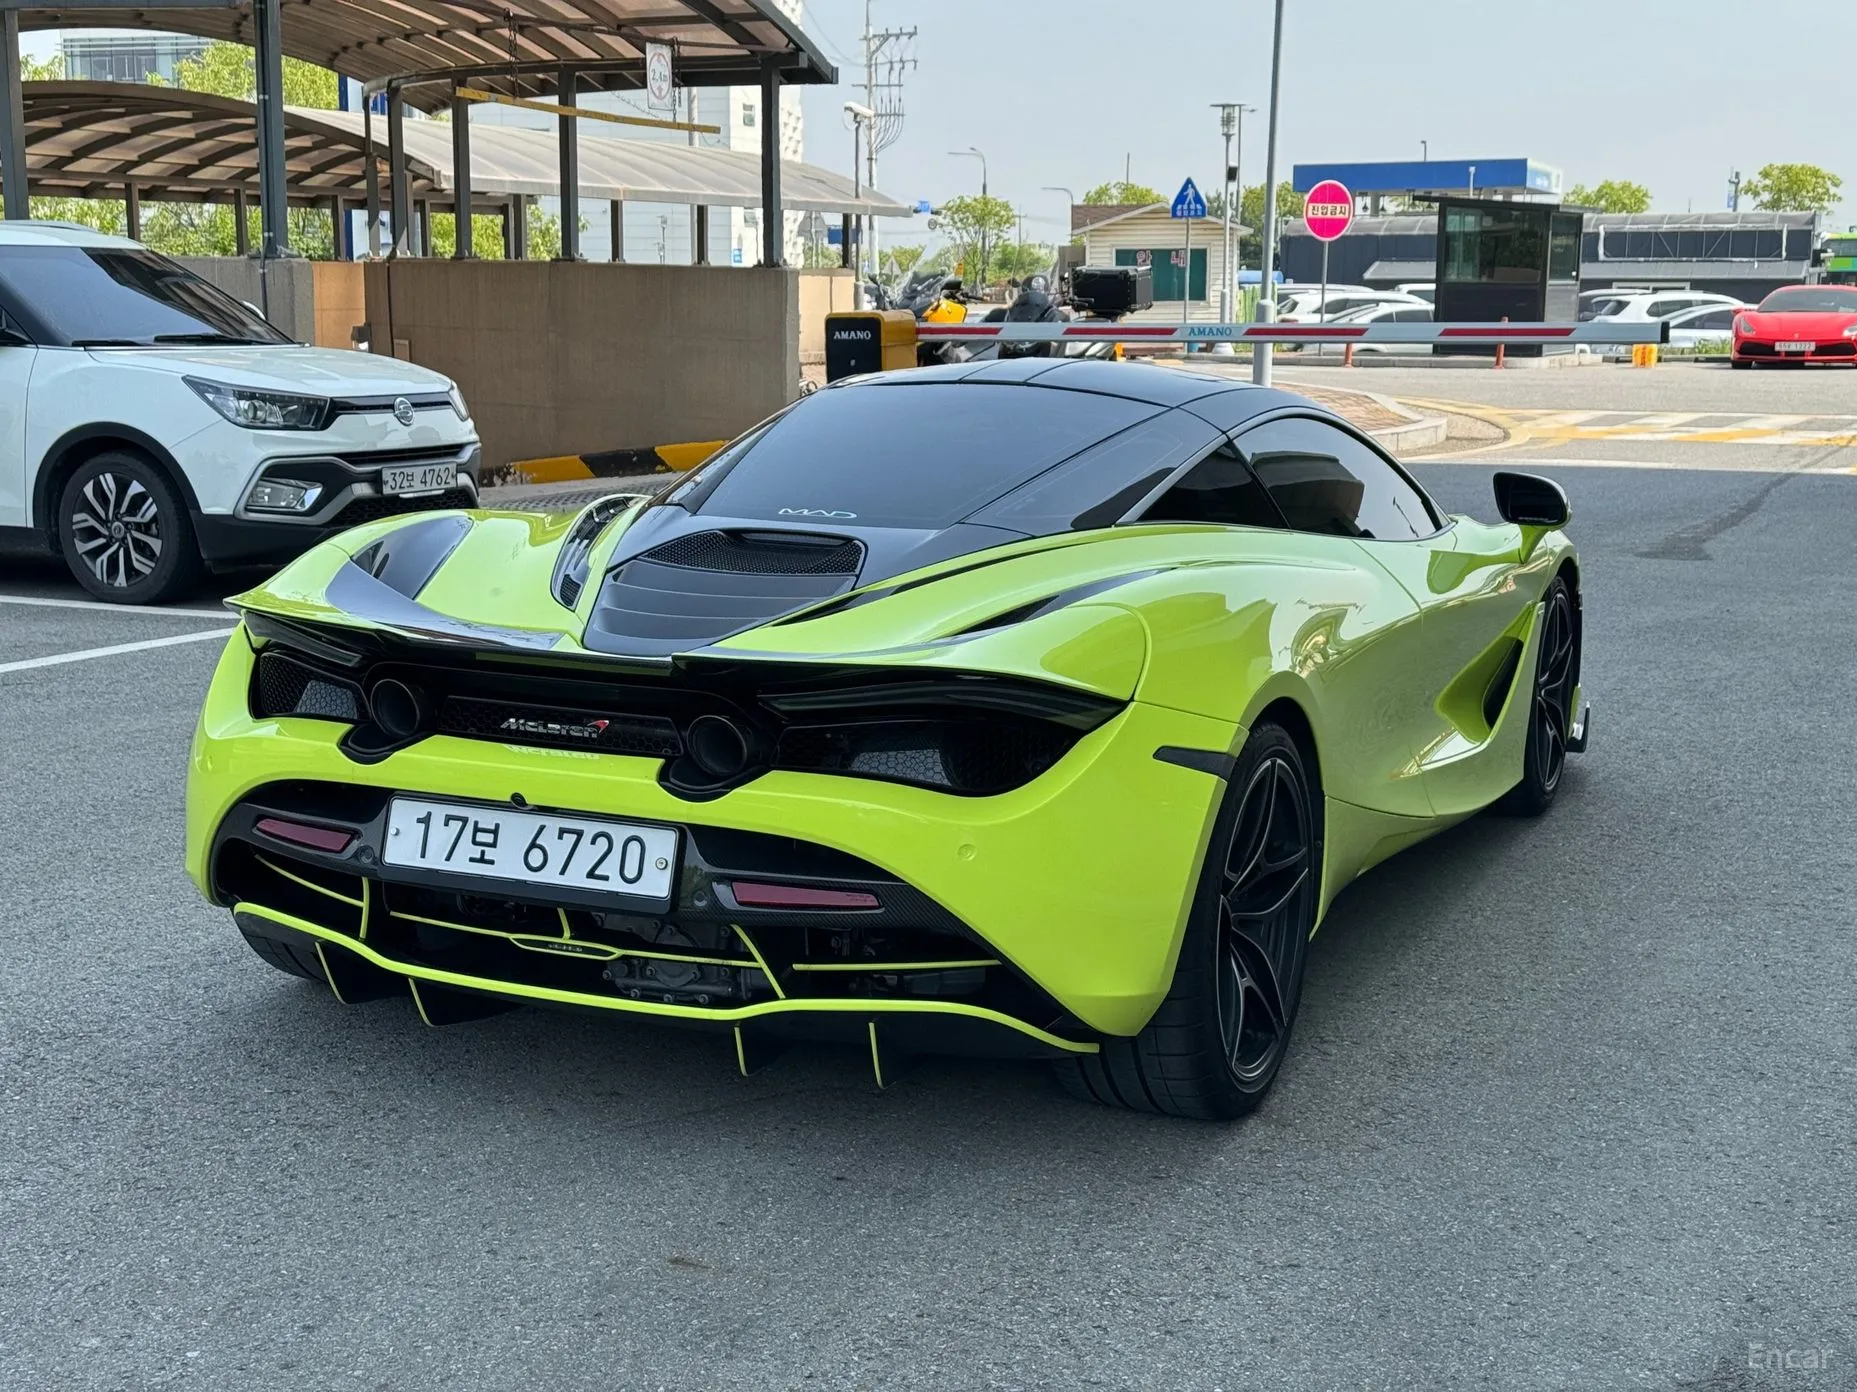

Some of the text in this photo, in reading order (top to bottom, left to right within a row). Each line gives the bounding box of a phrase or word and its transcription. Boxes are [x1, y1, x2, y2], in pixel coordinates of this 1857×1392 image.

[1311, 205, 1347, 216] 진입금지
[833, 330, 871, 340] AMANO
[1188, 327, 1232, 337] AMANO
[389, 467, 451, 491] 32보 4762
[416, 811, 647, 885] 17보 6720
